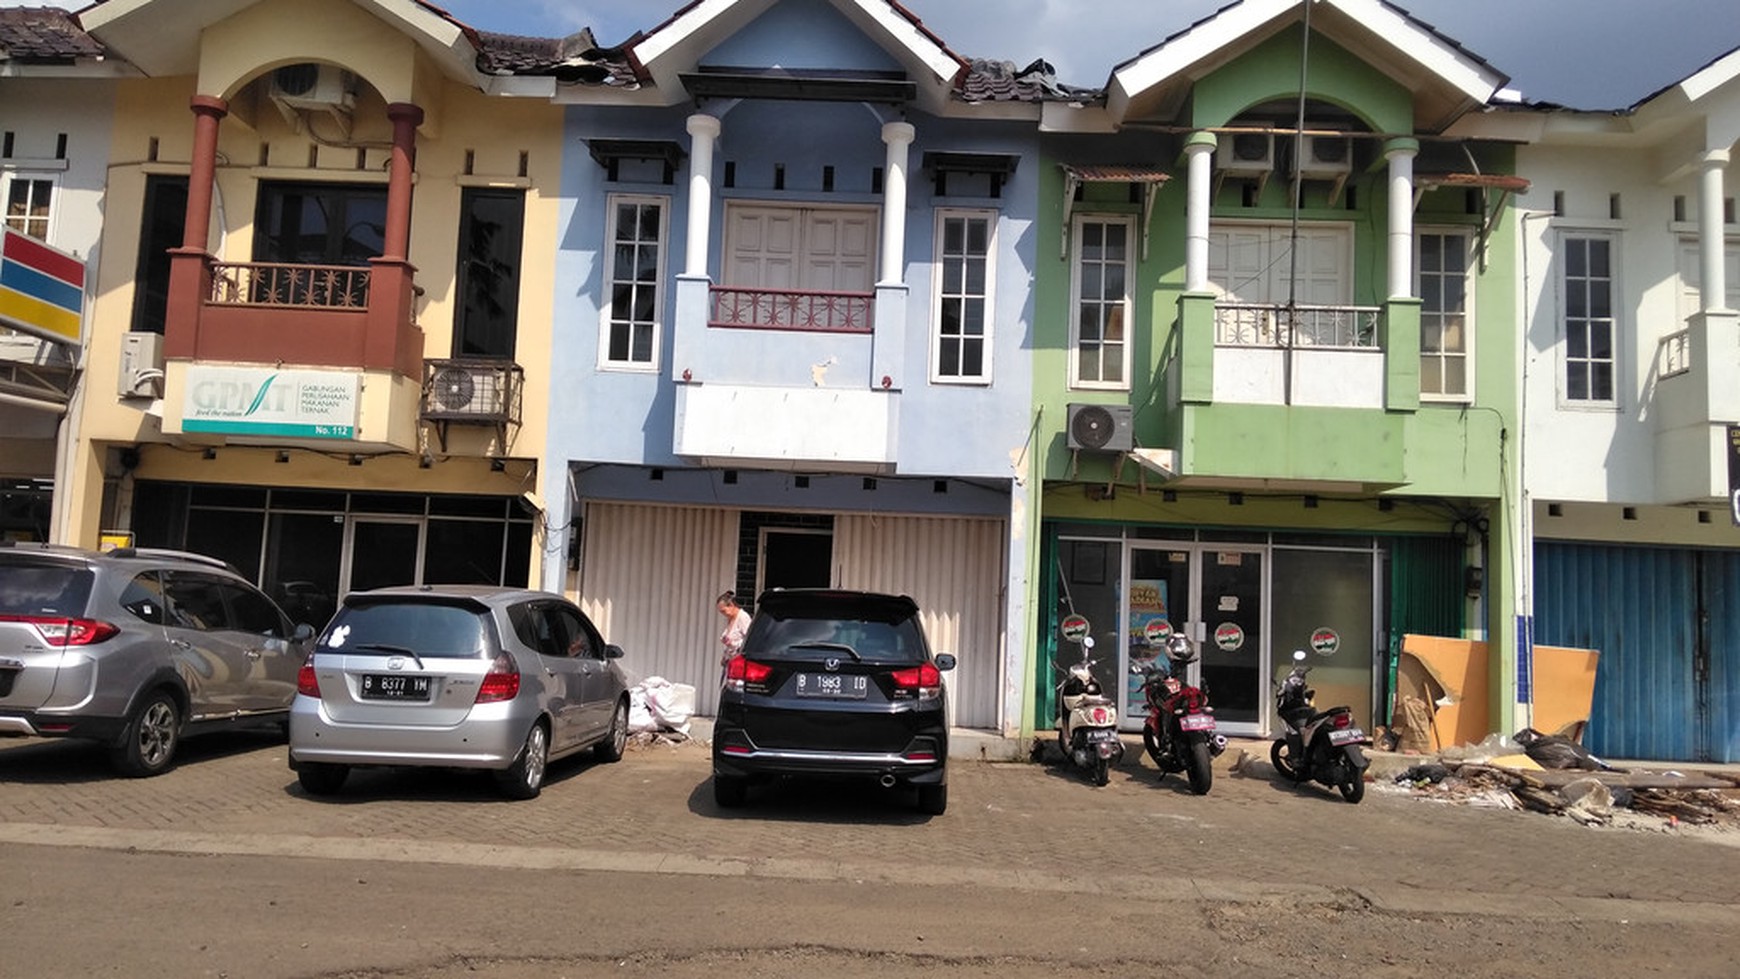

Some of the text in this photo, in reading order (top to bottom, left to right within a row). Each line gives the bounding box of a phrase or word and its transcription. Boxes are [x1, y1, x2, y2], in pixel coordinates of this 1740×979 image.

[301, 385, 346, 394] GABUNGAN
[301, 392, 350, 401] PERUSAHAAN
[301, 399, 340, 407] MAKANAN
[301, 406, 329, 415] TERNAK
[315, 425, 348, 436] No. 112
[365, 676, 372, 689] B
[381, 677, 406, 690] 8377
[799, 674, 806, 687] B
